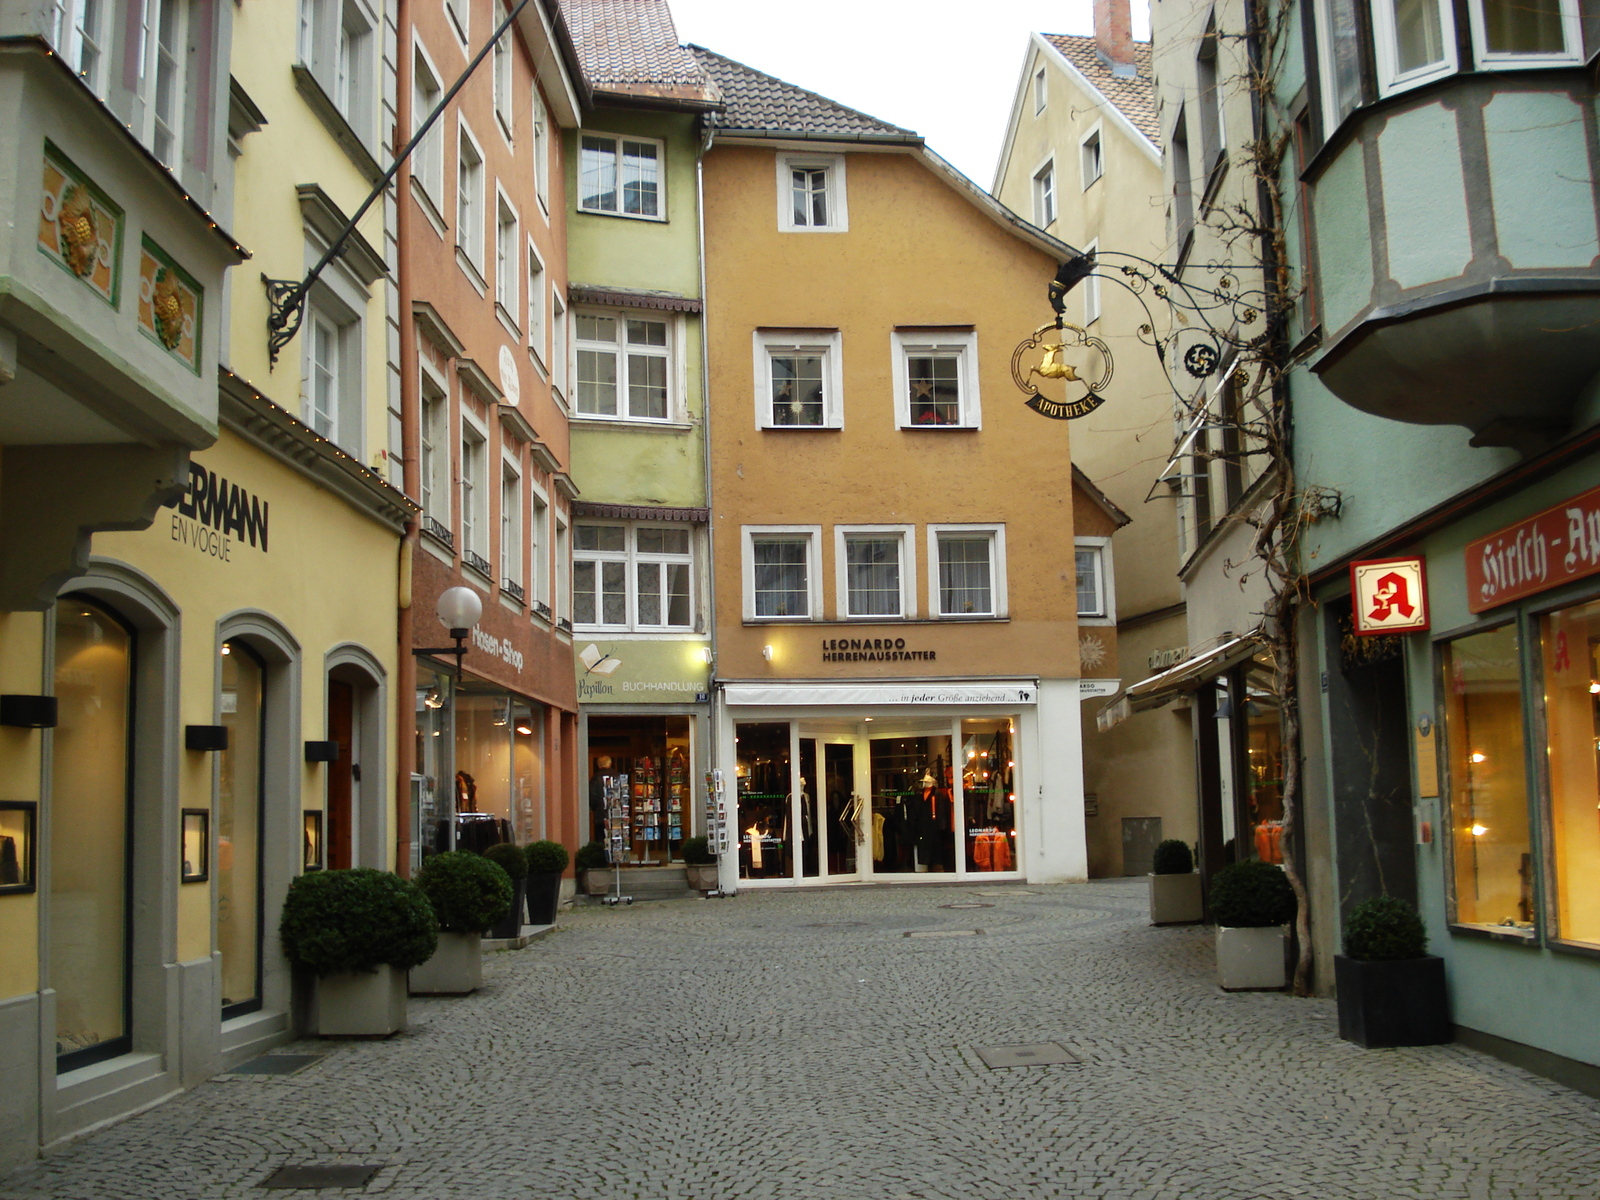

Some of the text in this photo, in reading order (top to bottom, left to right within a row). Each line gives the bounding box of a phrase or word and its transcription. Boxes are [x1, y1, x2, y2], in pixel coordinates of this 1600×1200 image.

[1036, 395, 1098, 417] APOTHEKE
[172, 514, 231, 562] EN VOGUE
[822, 637, 906, 651] LEONARDO
[822, 651, 937, 662] HERRENAUSSTATTER
[577, 679, 614, 698] Papillon
[622, 681, 704, 692] BUCHHANDLUNG
[900, 693, 909, 702] in
[910, 693, 936, 704] jeder
[937, 693, 963, 703] Größe
[964, 693, 1006, 703] anziehend
